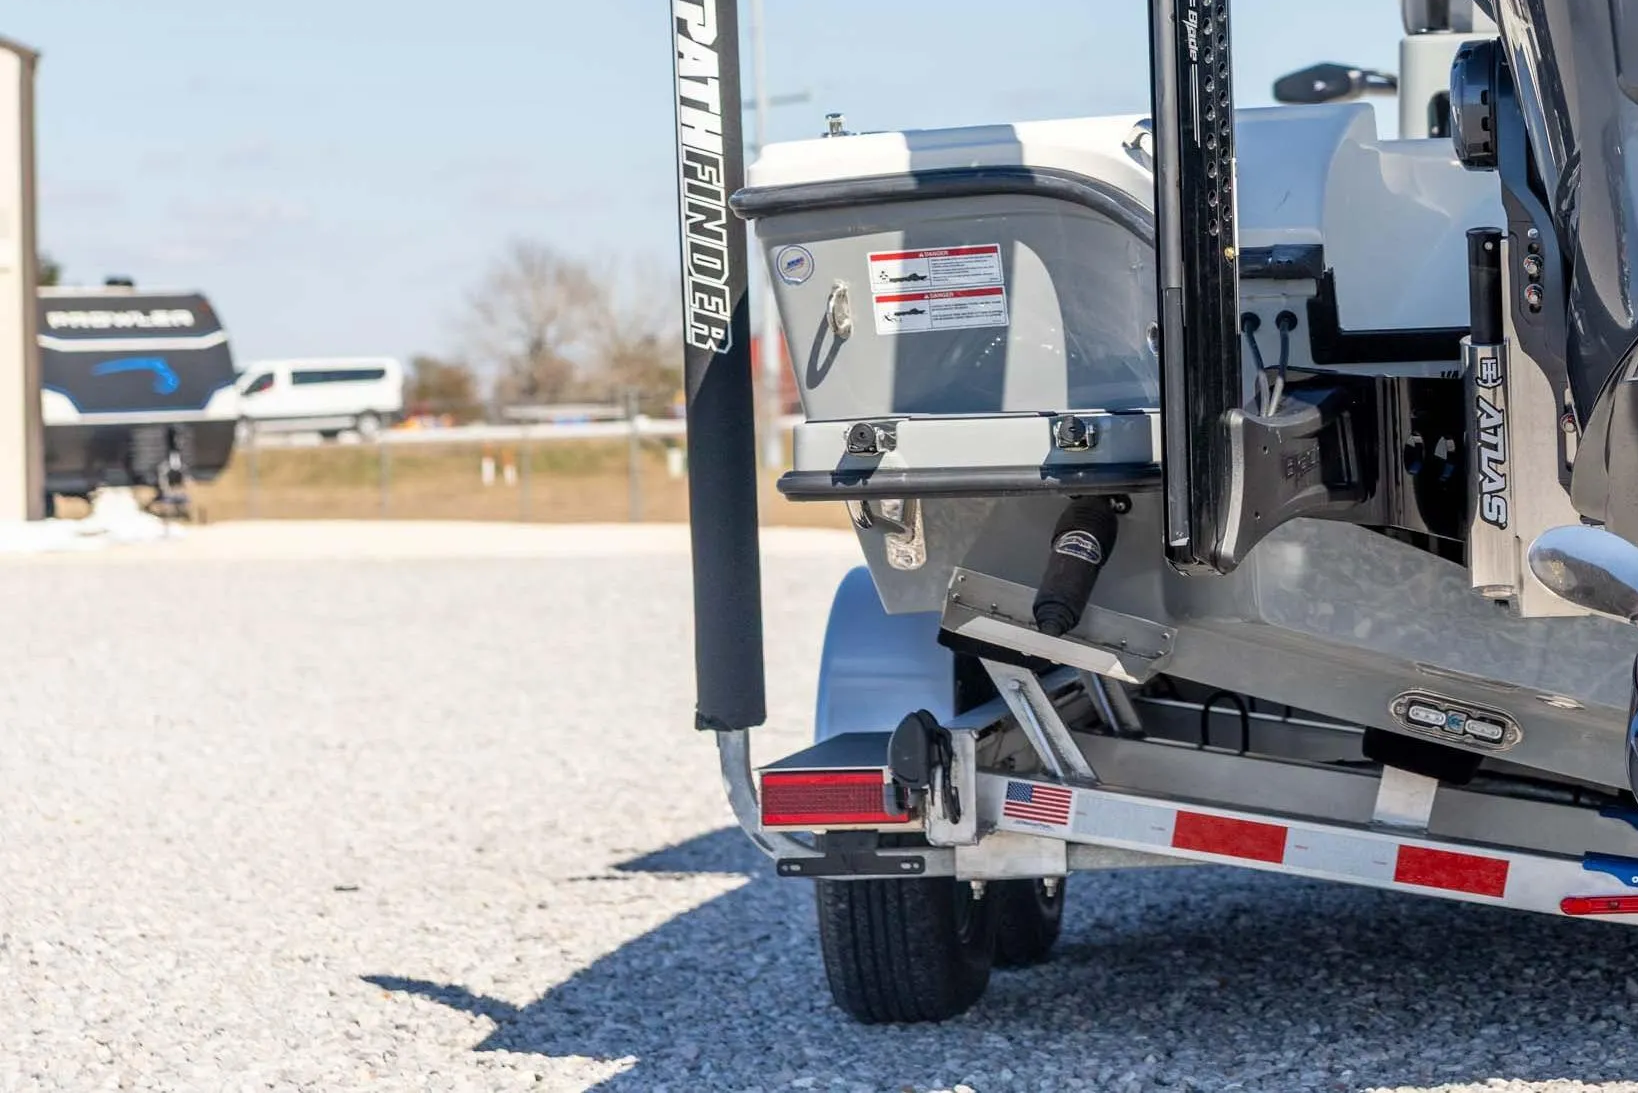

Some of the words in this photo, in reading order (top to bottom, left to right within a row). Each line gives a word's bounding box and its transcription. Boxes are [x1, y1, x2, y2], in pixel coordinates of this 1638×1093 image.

[1182, 9, 1199, 62] Blade
[46, 309, 196, 329] PROWLER
[1476, 395, 1508, 529] ATLAS
